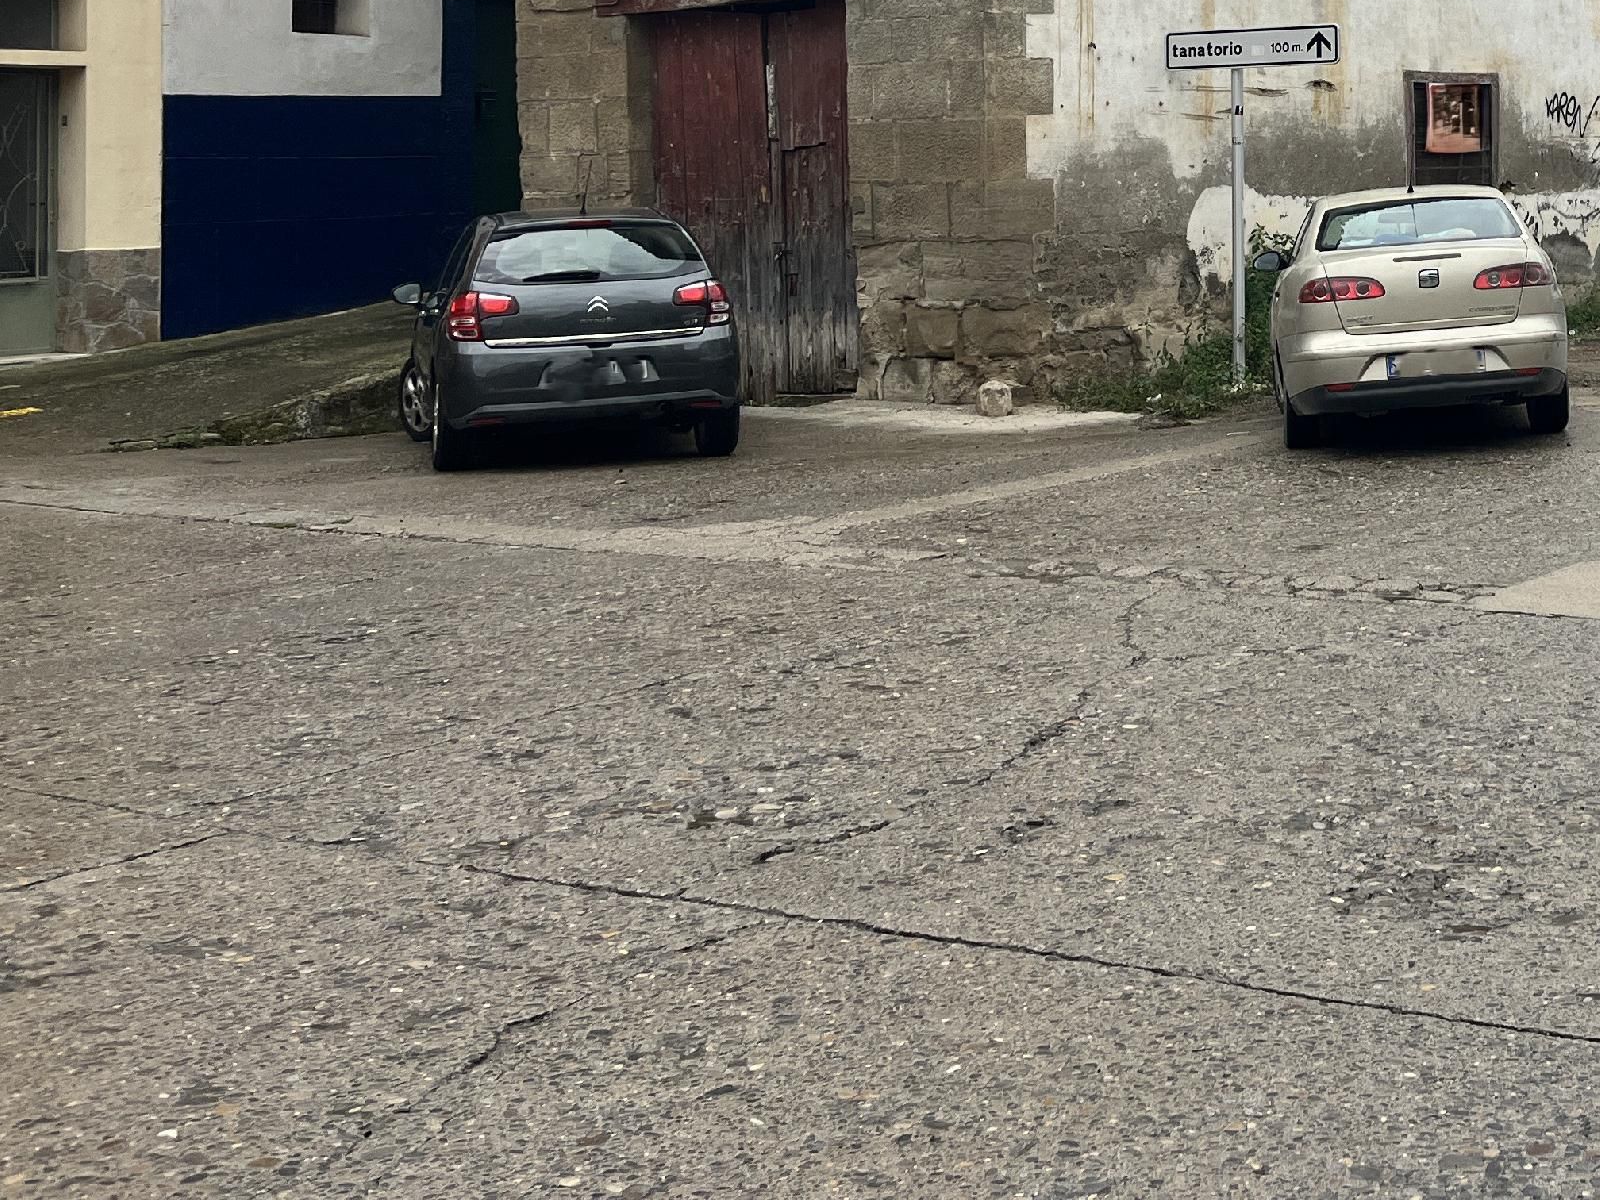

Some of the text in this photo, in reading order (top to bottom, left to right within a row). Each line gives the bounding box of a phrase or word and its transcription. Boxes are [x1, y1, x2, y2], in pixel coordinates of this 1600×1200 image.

[1172, 41, 1303, 58] tanatorio 100 m.
